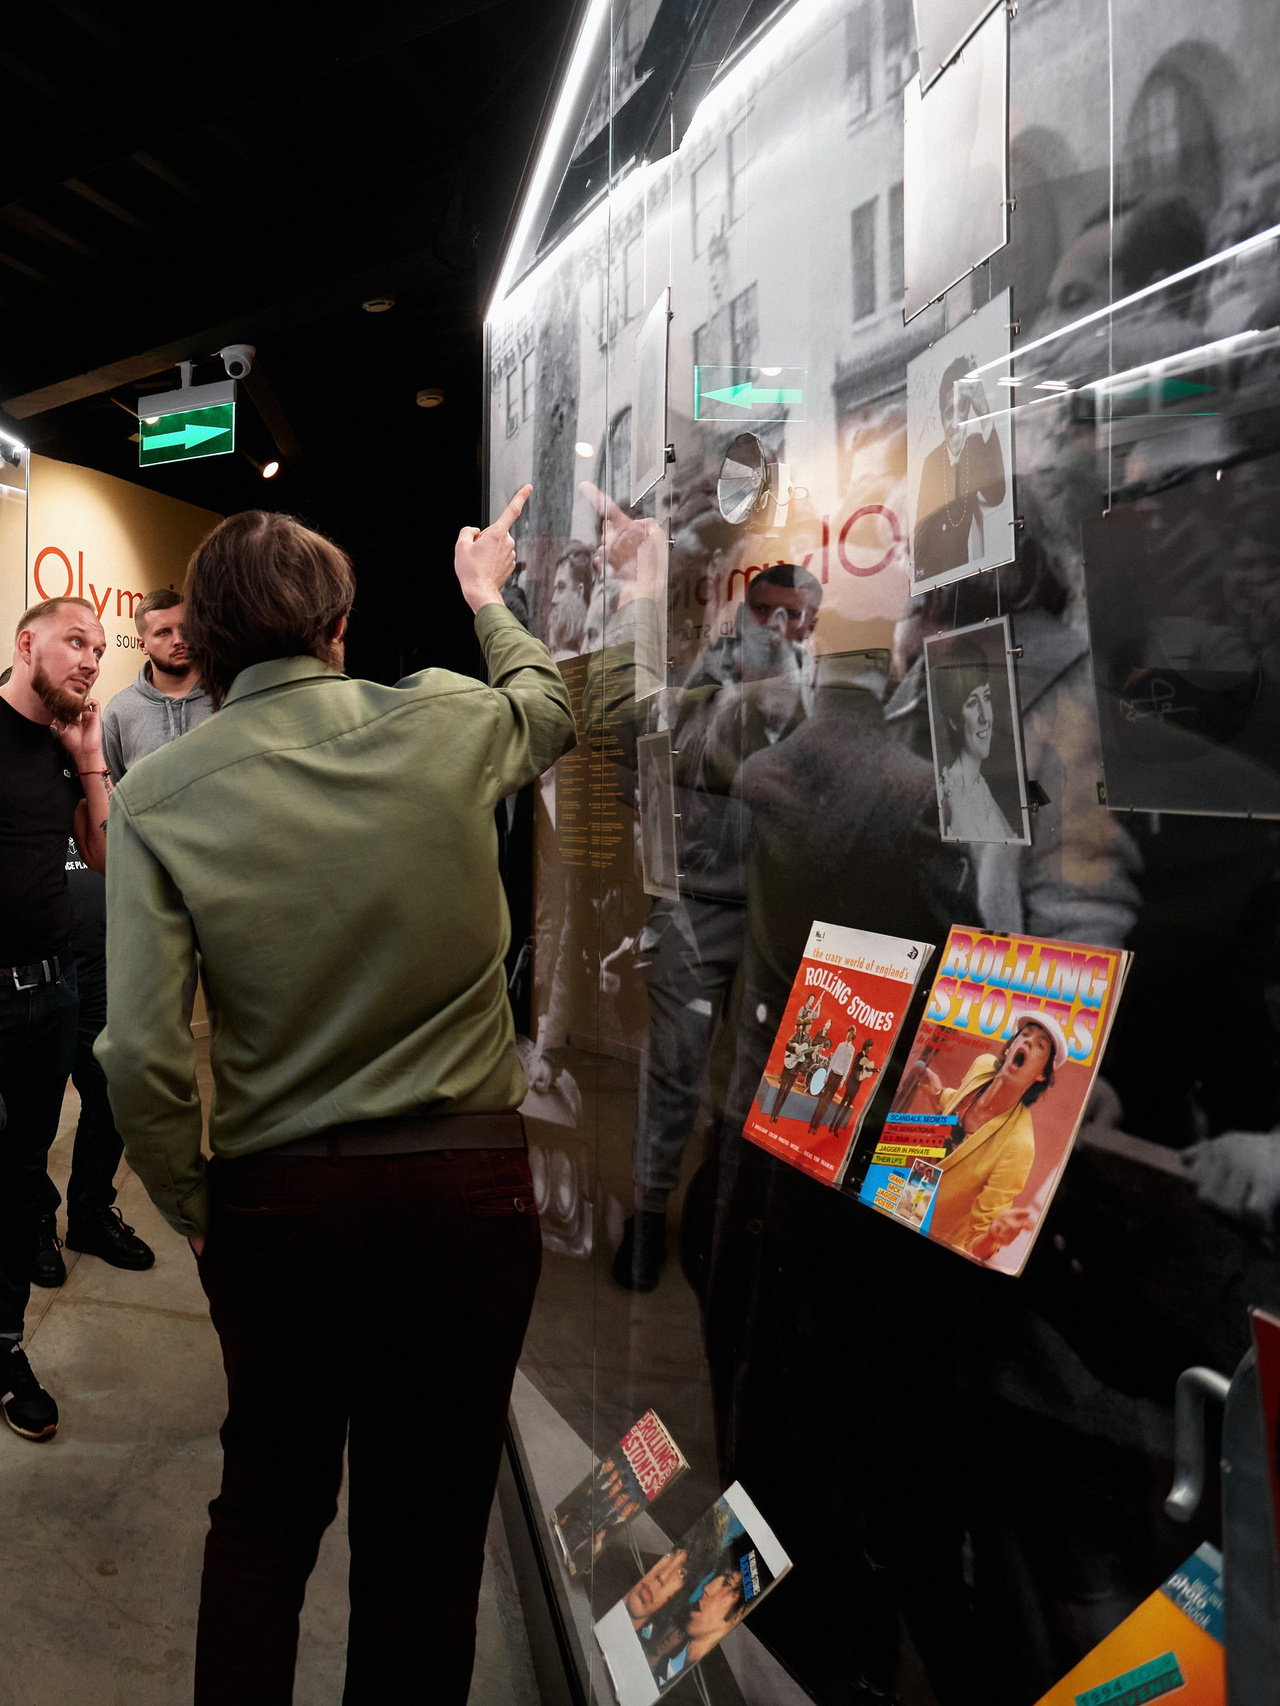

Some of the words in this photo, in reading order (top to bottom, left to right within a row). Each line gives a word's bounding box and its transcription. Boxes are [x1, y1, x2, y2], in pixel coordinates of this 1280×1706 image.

[116, 634, 141, 650] SOU
[812, 947, 824, 959] the
[825, 952, 843, 966] crazy
[844, 956, 865, 969] world
[865, 960, 875, 971] of
[875, 963, 910, 980] england's
[940, 932, 1111, 1010] ROLLING
[846, 996, 894, 1032] STONES
[890, 1114, 921, 1123] SCANDALS,
[875, 1155, 891, 1163] THEIR
[907, 1147, 931, 1155] PRIVATE
[877, 1188, 899, 1203] JAGGER
[874, 1197, 895, 1212] POSTER
[639, 1418, 676, 1472] ROLLING
[624, 1435, 660, 1490] STONES
